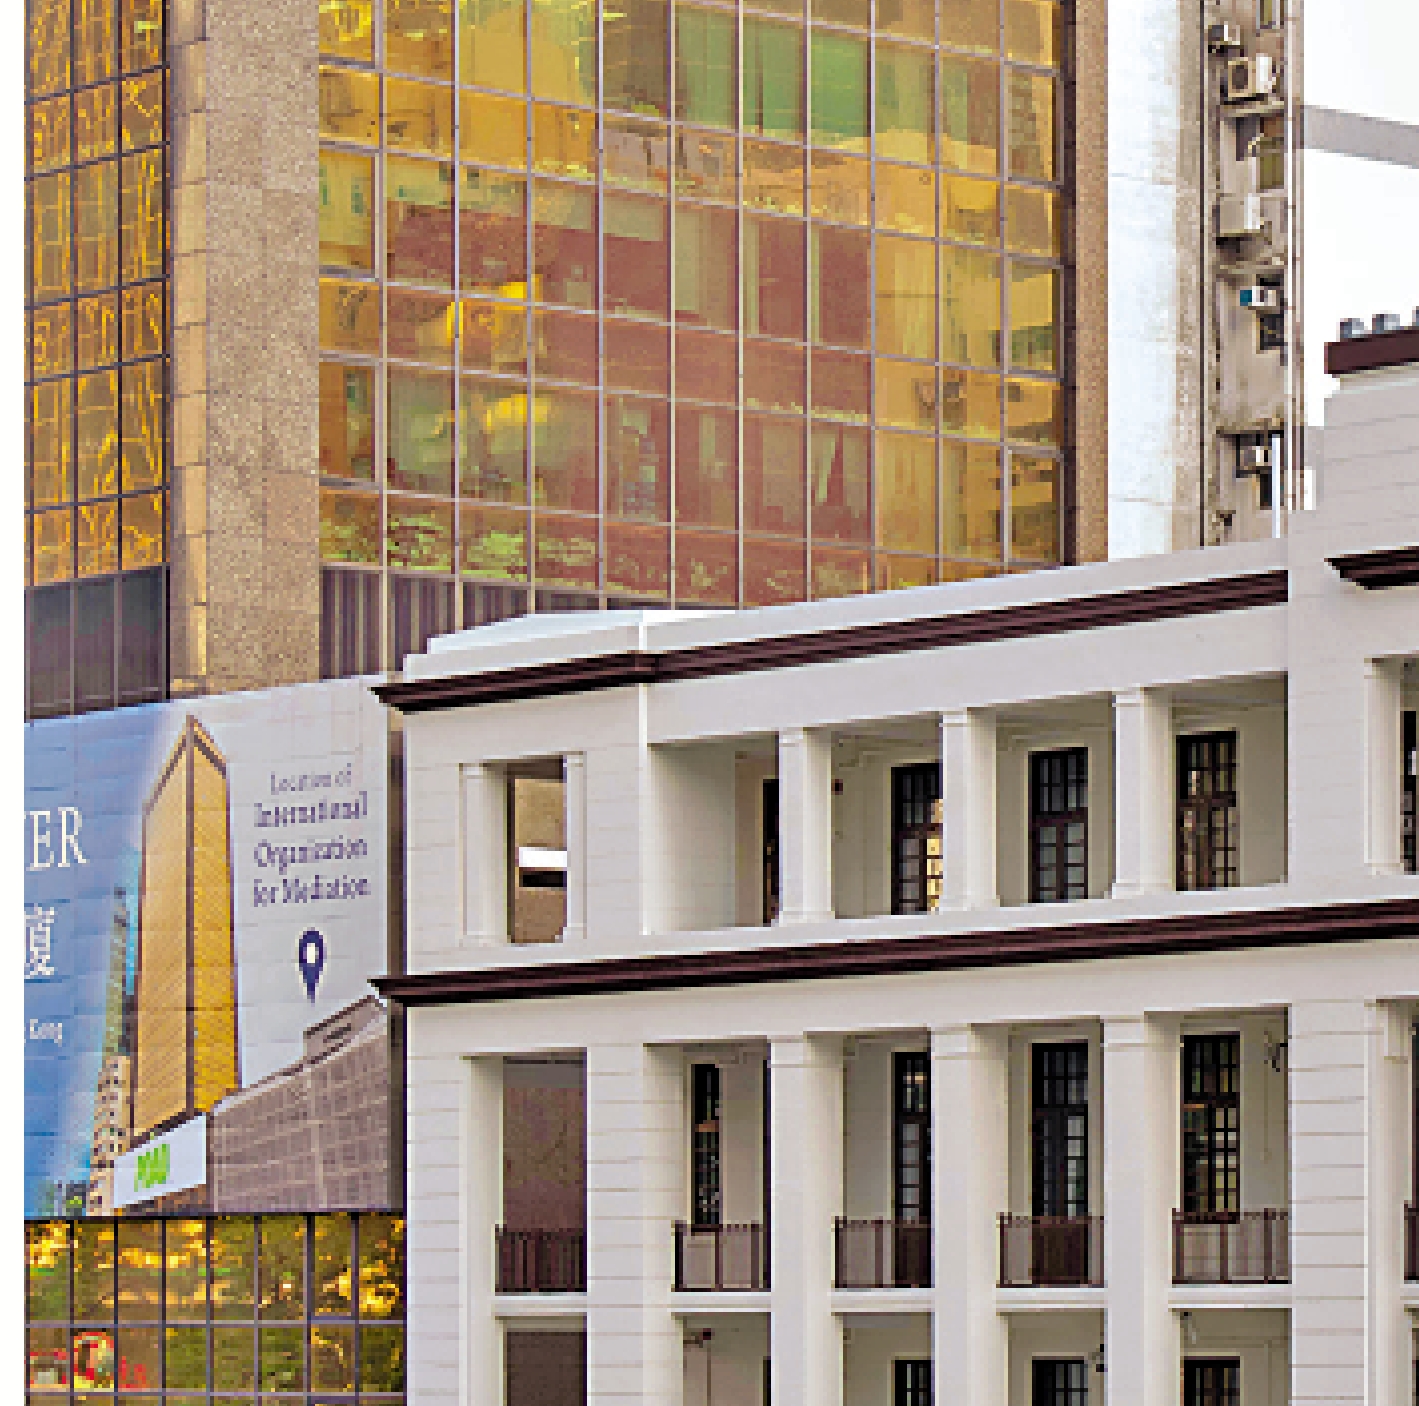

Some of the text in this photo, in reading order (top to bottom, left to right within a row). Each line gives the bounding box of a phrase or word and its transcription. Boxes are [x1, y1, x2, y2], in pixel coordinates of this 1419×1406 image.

[253, 790, 368, 828] International
[24, 806, 88, 871] ER
[253, 834, 368, 875] Organization
[253, 874, 372, 907] for Mediation
